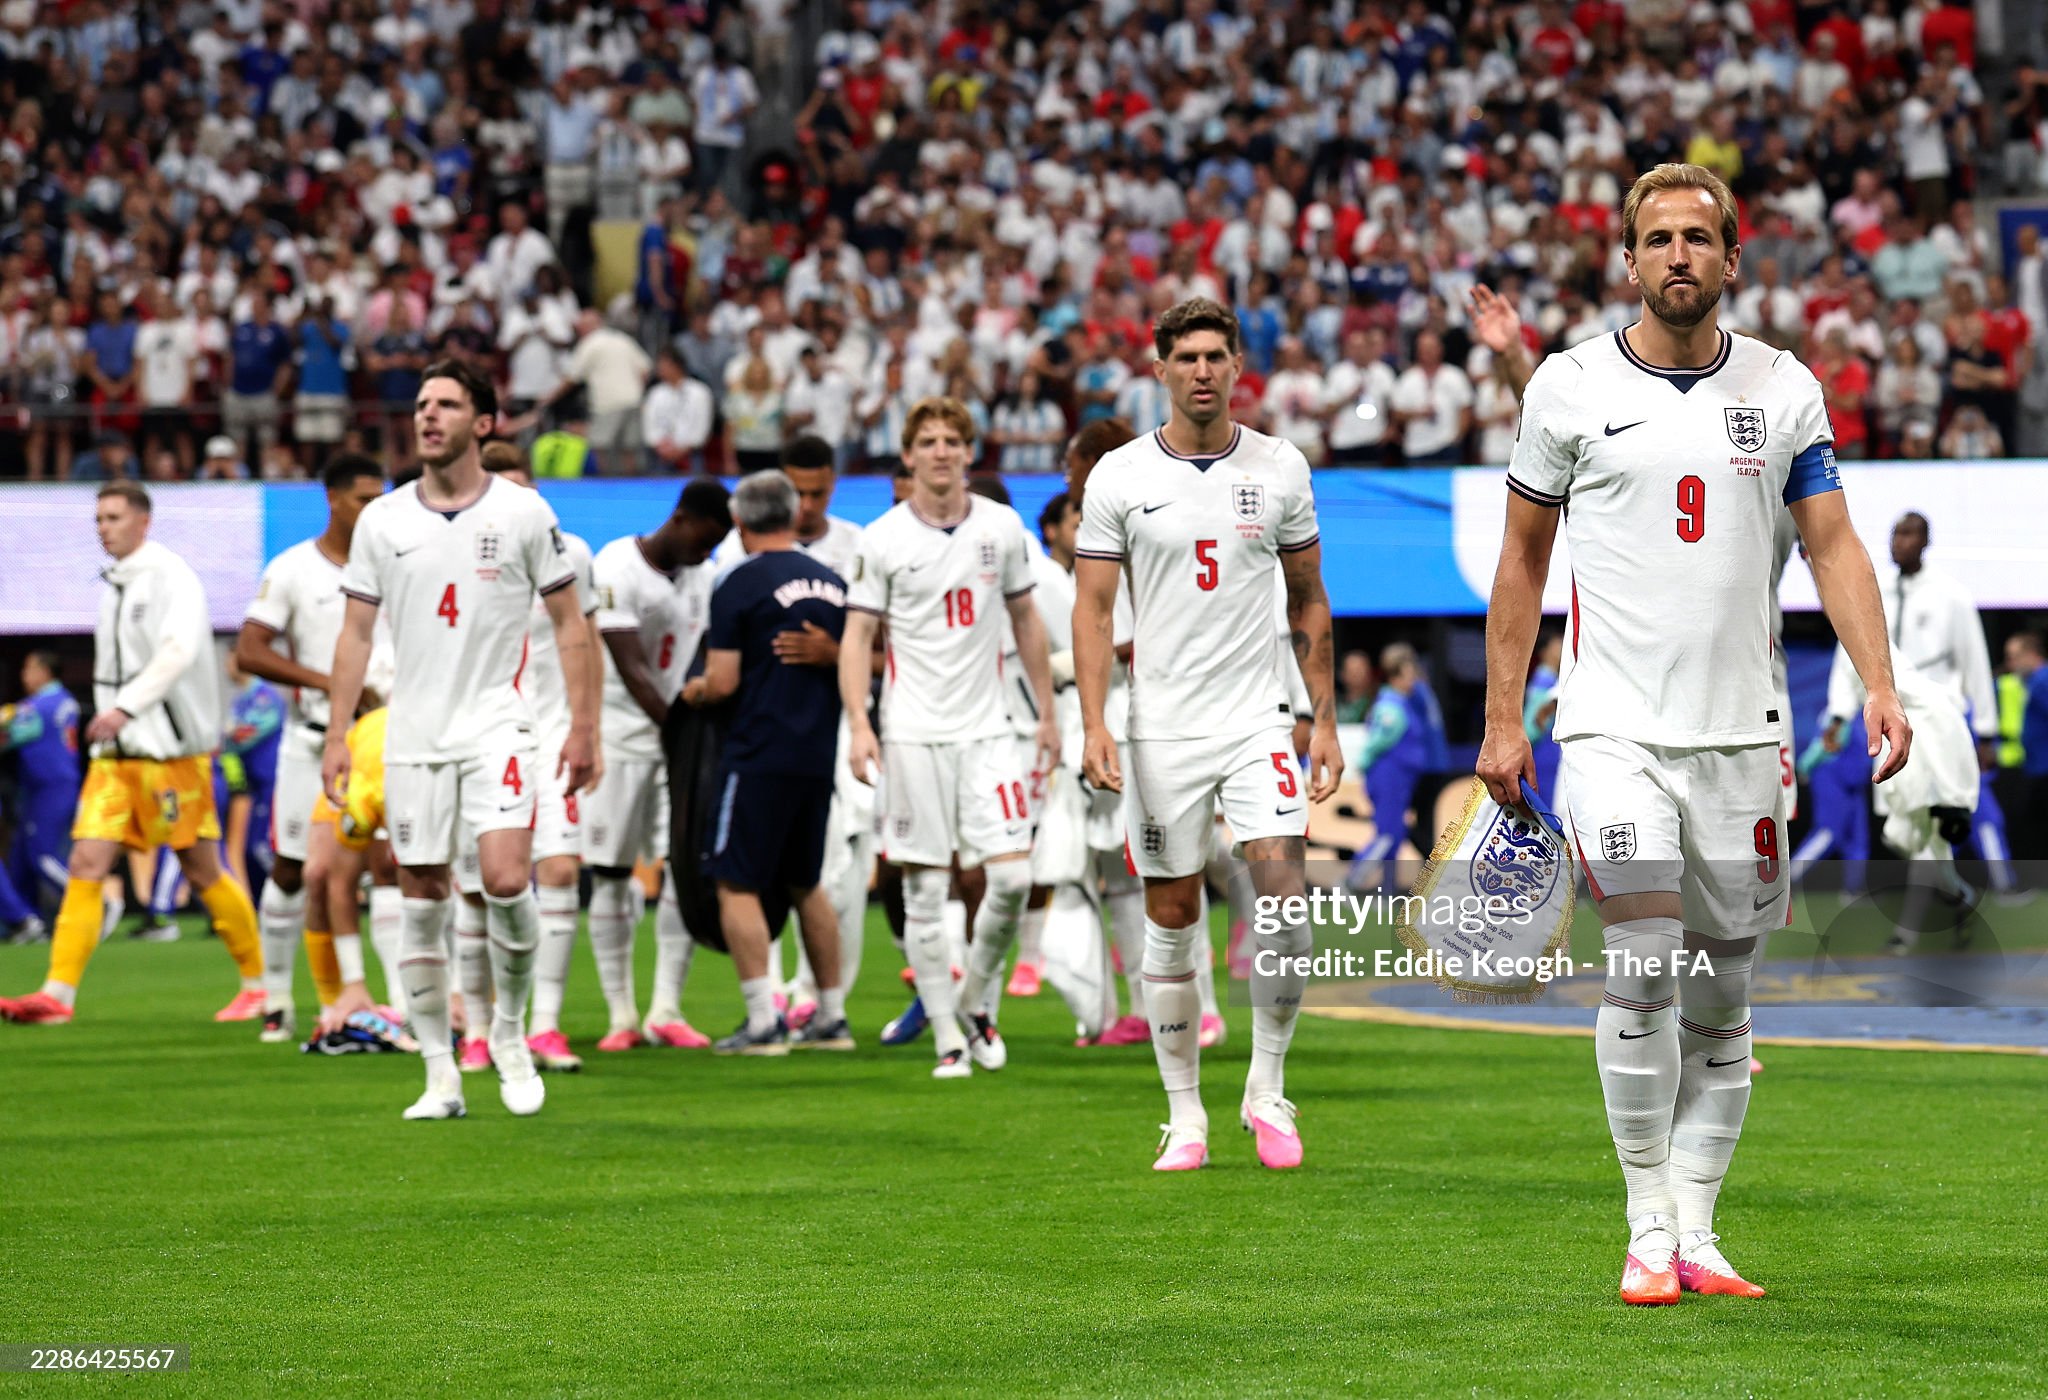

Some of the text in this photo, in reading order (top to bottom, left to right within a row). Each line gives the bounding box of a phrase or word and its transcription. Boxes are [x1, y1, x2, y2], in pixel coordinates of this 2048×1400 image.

[1729, 457, 1766, 468] ARGENTINA
[1677, 475, 1705, 543] 9
[1195, 540, 1218, 591] 5
[437, 583, 459, 627] 4
[943, 587, 975, 628] 18
[502, 756, 523, 796] 4
[1270, 752, 1297, 798] 5
[996, 781, 1028, 820] 18
[1753, 816, 1780, 884] 9
[1442, 936, 1472, 959] Wednesday
[1454, 930, 1494, 958] Atlanta Stadi
[1465, 923, 1495, 944] Se-Final
[1486, 922, 1498, 933] Cup
[1498, 929, 1514, 941] 2026
[1159, 1021, 1189, 1034] ENG
